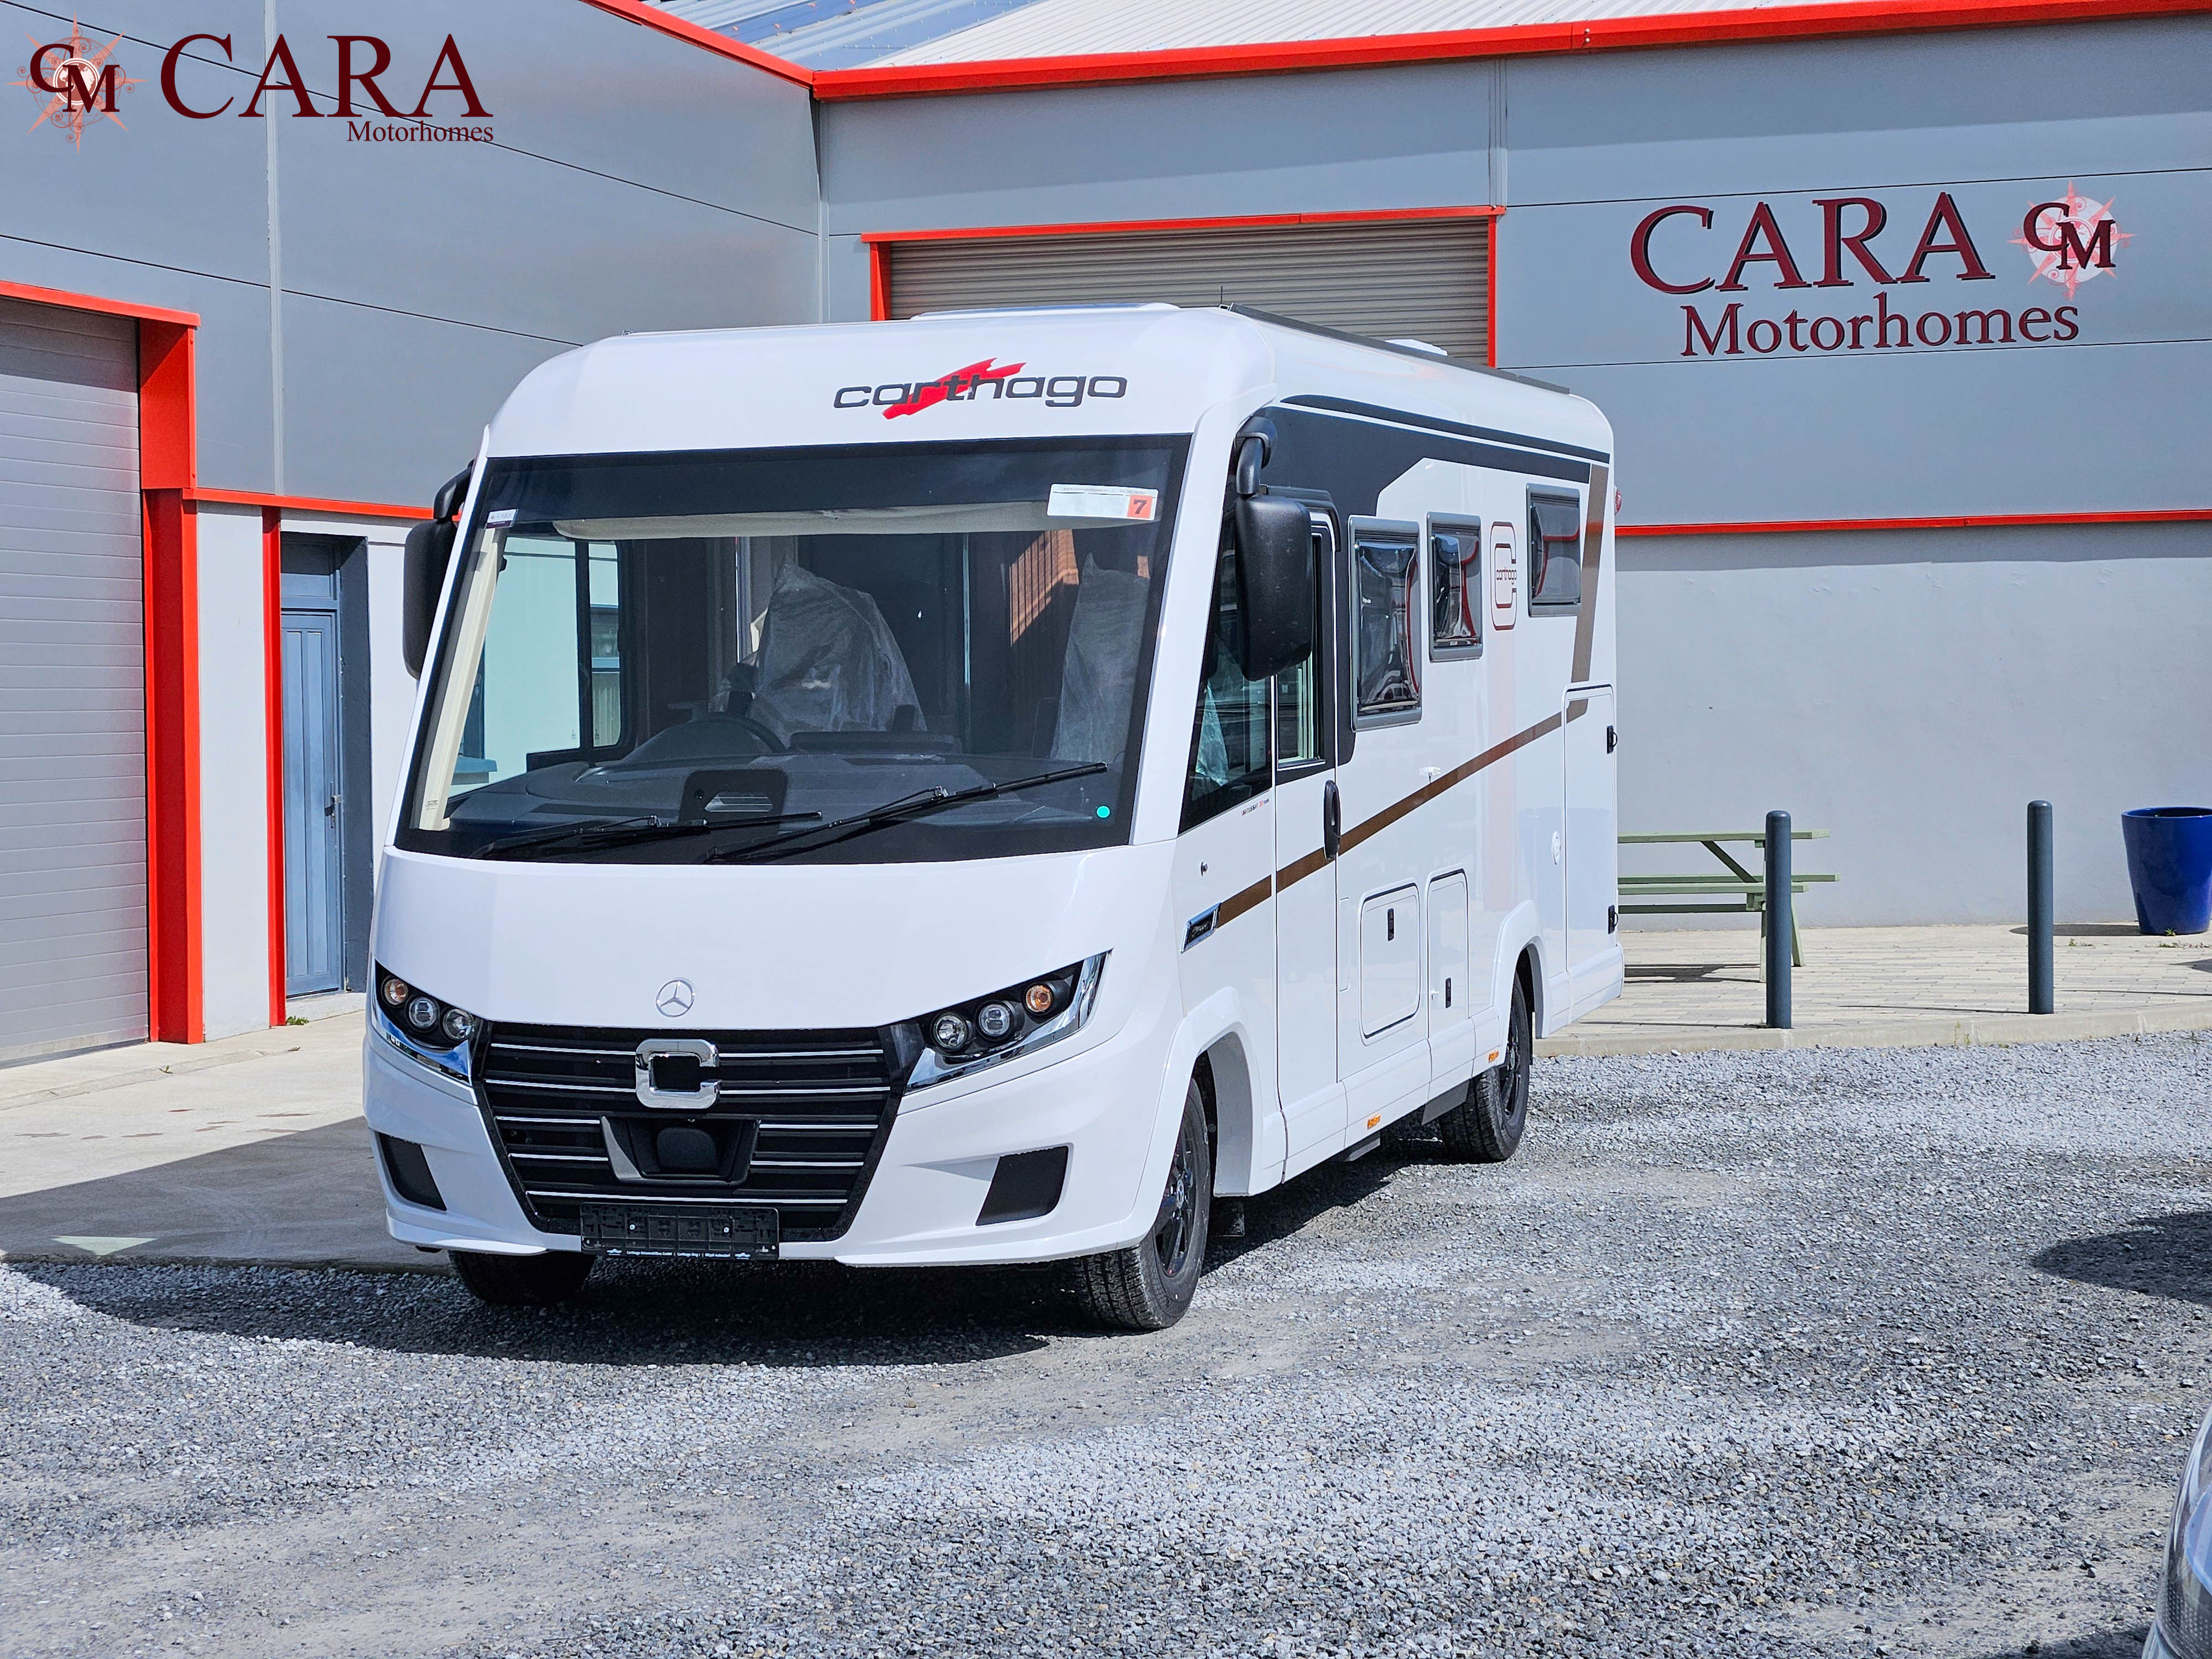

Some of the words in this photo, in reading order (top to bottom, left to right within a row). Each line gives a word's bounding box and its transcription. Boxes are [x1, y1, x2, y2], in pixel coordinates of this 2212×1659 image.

[1630, 191, 1996, 295] CARA
[1680, 291, 2079, 357] Motorhomes
[833, 374, 1128, 408] carthago
[1133, 499, 1147, 515] 7
